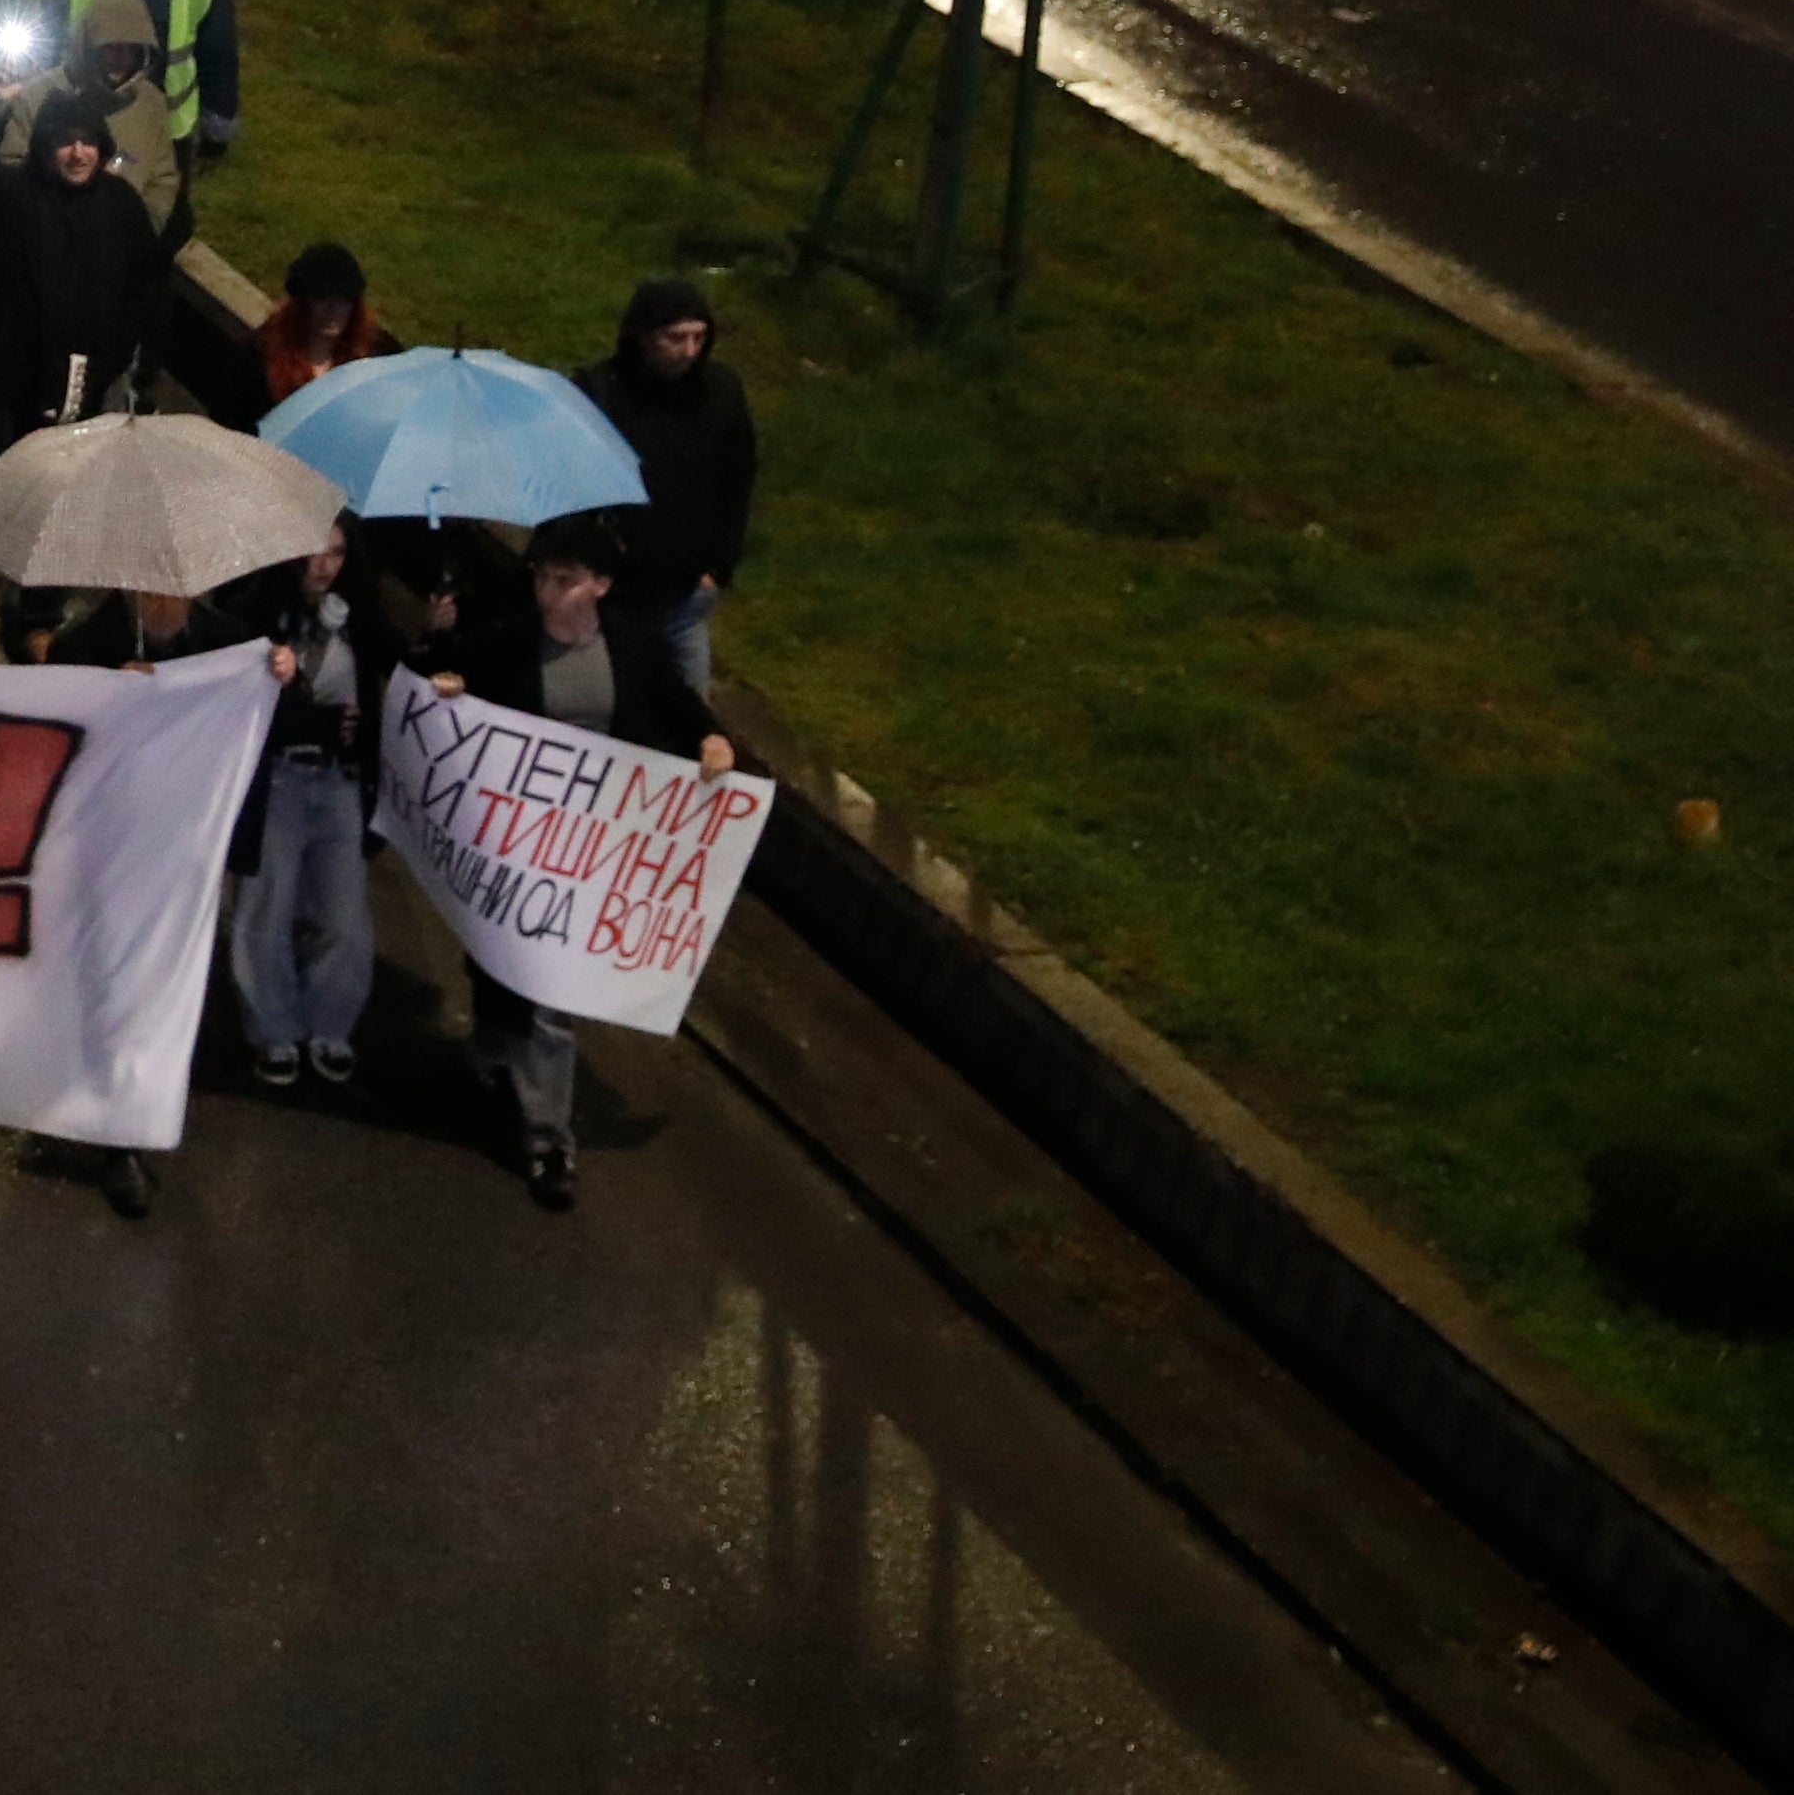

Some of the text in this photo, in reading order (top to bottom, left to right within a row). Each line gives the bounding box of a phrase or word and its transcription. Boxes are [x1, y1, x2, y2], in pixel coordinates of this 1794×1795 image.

[399, 689, 761, 848] КУПЕН МИР
[422, 763, 708, 911] И ТИШИНА
[514, 878, 578, 946] ОД
[586, 891, 707, 977] ВОЈНА
